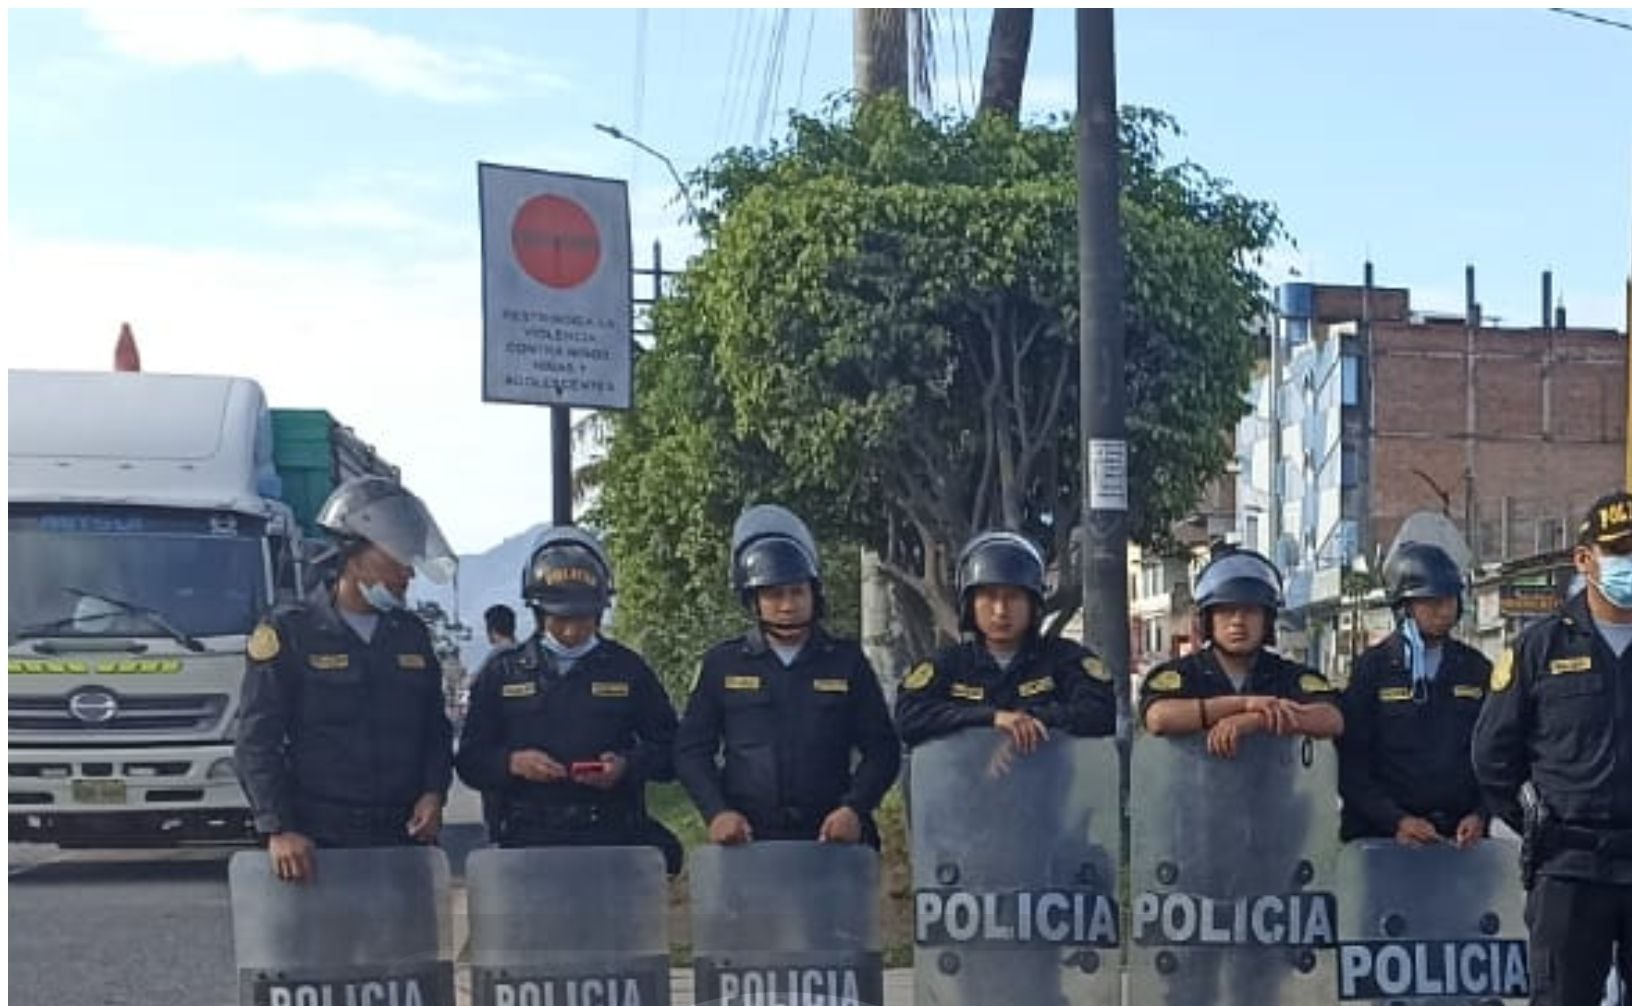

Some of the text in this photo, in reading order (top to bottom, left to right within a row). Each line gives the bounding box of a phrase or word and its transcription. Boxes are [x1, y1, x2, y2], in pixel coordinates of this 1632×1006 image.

[916, 890, 1118, 942] POLICIA
[1131, 891, 1338, 944] POLICIA
[1341, 944, 1529, 996] POLICIA
